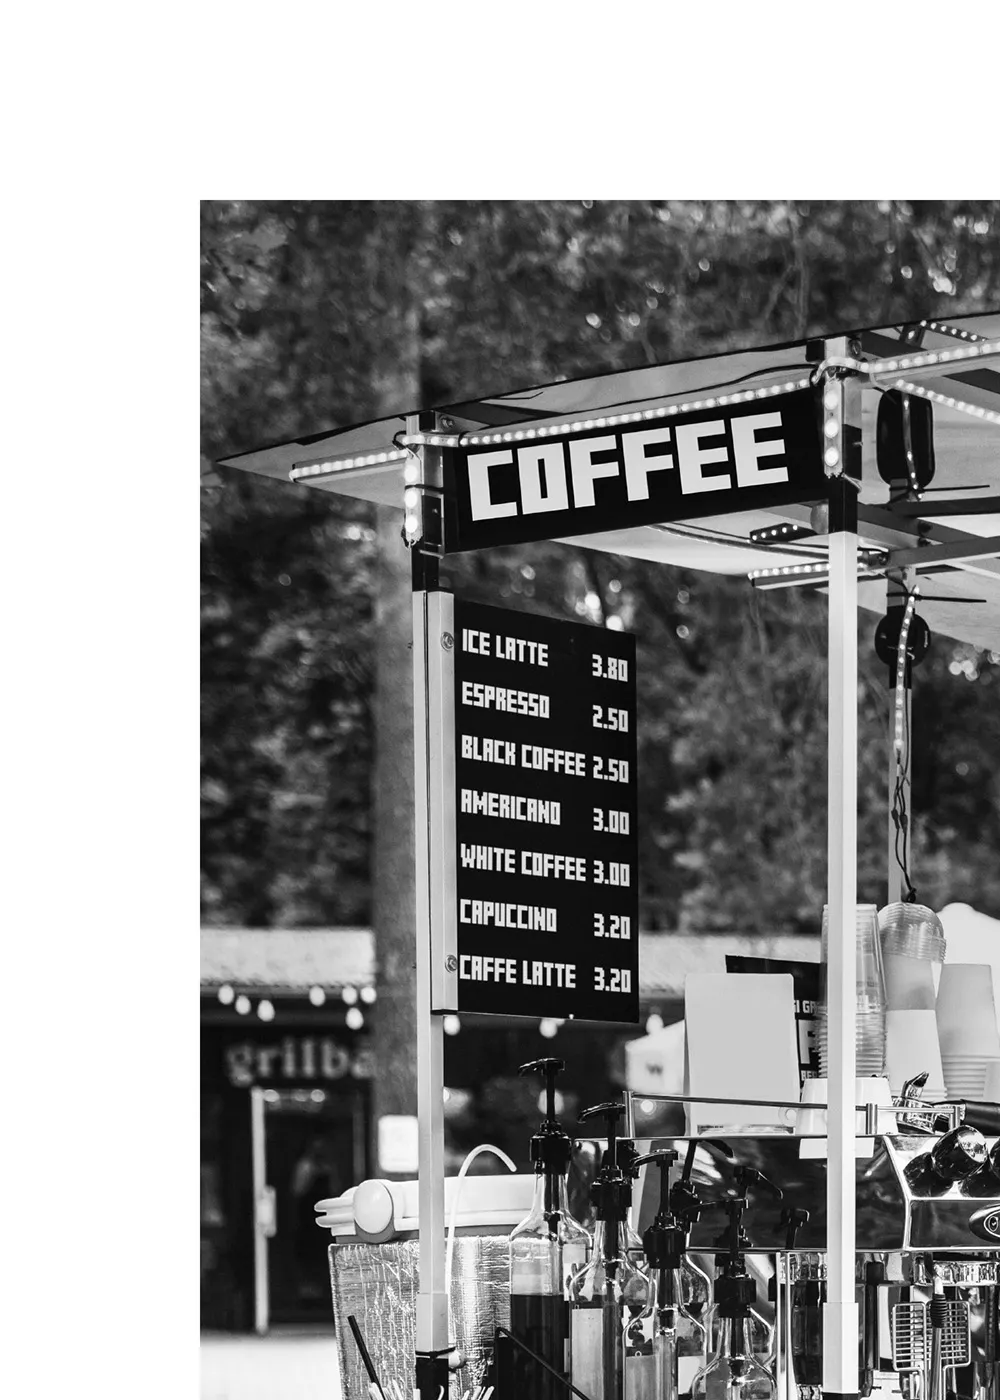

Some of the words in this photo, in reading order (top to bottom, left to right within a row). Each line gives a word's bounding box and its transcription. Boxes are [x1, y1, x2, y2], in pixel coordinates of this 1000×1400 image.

[466, 411, 790, 522] COFFEE
[463, 629, 490, 655] ICE
[496, 635, 548, 666] LATTE
[593, 654, 627, 681] 3.80
[462, 681, 549, 718] ESPRESSO
[593, 705, 628, 732] 2.50
[462, 735, 515, 765] BLACK
[522, 745, 585, 776] COFFEE
[593, 756, 628, 783] 2.50
[461, 789, 560, 825] AMERICANO
[594, 808, 629, 834] 3.00
[461, 844, 515, 873] WHITE
[522, 851, 586, 881] COFFEE
[594, 860, 629, 886] 3.00
[460, 899, 556, 932] CAPUCCINO
[594, 913, 630, 939] 3.20
[460, 955, 516, 983] CAFFE
[523, 961, 575, 988] LATTE
[595, 967, 631, 992] 3.20
